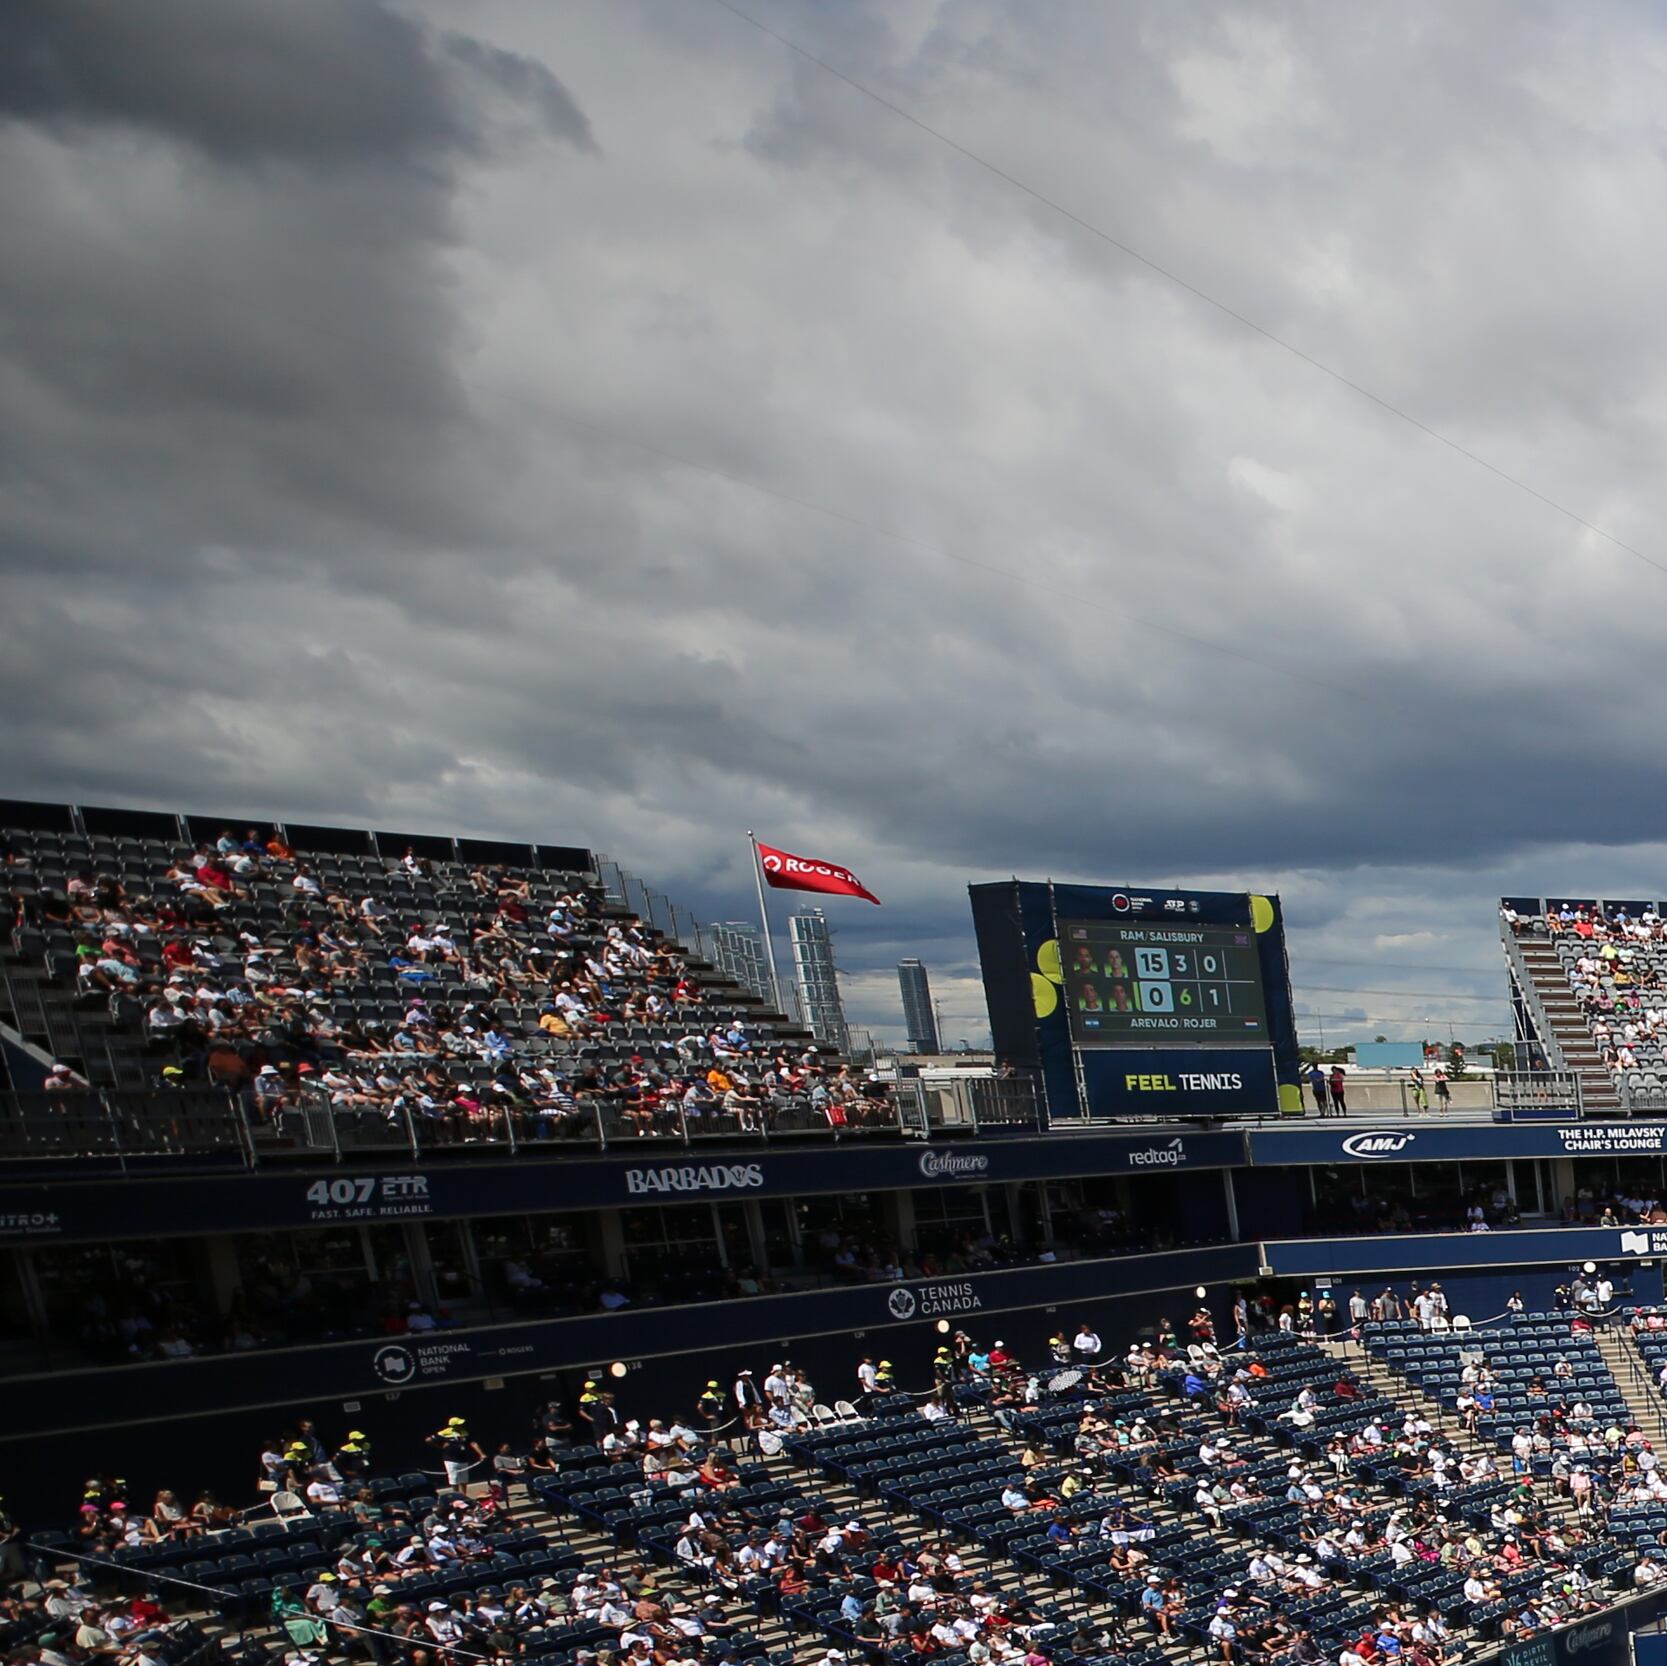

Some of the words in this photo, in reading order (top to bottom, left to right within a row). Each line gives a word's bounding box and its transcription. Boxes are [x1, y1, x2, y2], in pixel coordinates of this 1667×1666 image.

[786, 858, 862, 886] ROGER
[1140, 953, 1163, 972] 15
[1175, 954, 1187, 972] 3
[1204, 955, 1216, 973] 0
[1150, 989, 1163, 1006] 0
[1180, 989, 1191, 1006] 6
[1209, 989, 1218, 1006] 1
[1126, 1074, 1176, 1091] FEEL
[1178, 1073, 1242, 1091] TENNIS
[1558, 1129, 1581, 1140] THE
[1584, 1128, 1605, 1139] H.P.
[1608, 1127, 1665, 1139] MILAVSKY
[1355, 1136, 1408, 1152] AMJ
[1565, 1139, 1611, 1150] CHAIR'S
[1614, 1138, 1662, 1149] LOUNGE
[918, 1149, 989, 1178] Cashmere
[625, 1163, 764, 1193] BARBADOS
[306, 1178, 375, 1204] 407
[381, 1175, 429, 1196] ETR
[0, 1211, 60, 1228] ITRO+
[311, 1210, 341, 1219] FAST.
[345, 1207, 376, 1217] SAFE.
[380, 1204, 433, 1216] RELIABLE.
[918, 1283, 973, 1300] TENNIS
[921, 1296, 981, 1314] CANADA
[417, 1342, 470, 1356] NATIONAL
[420, 1355, 450, 1366] BANK
[1522, 1642, 1547, 1658] DIRTY
